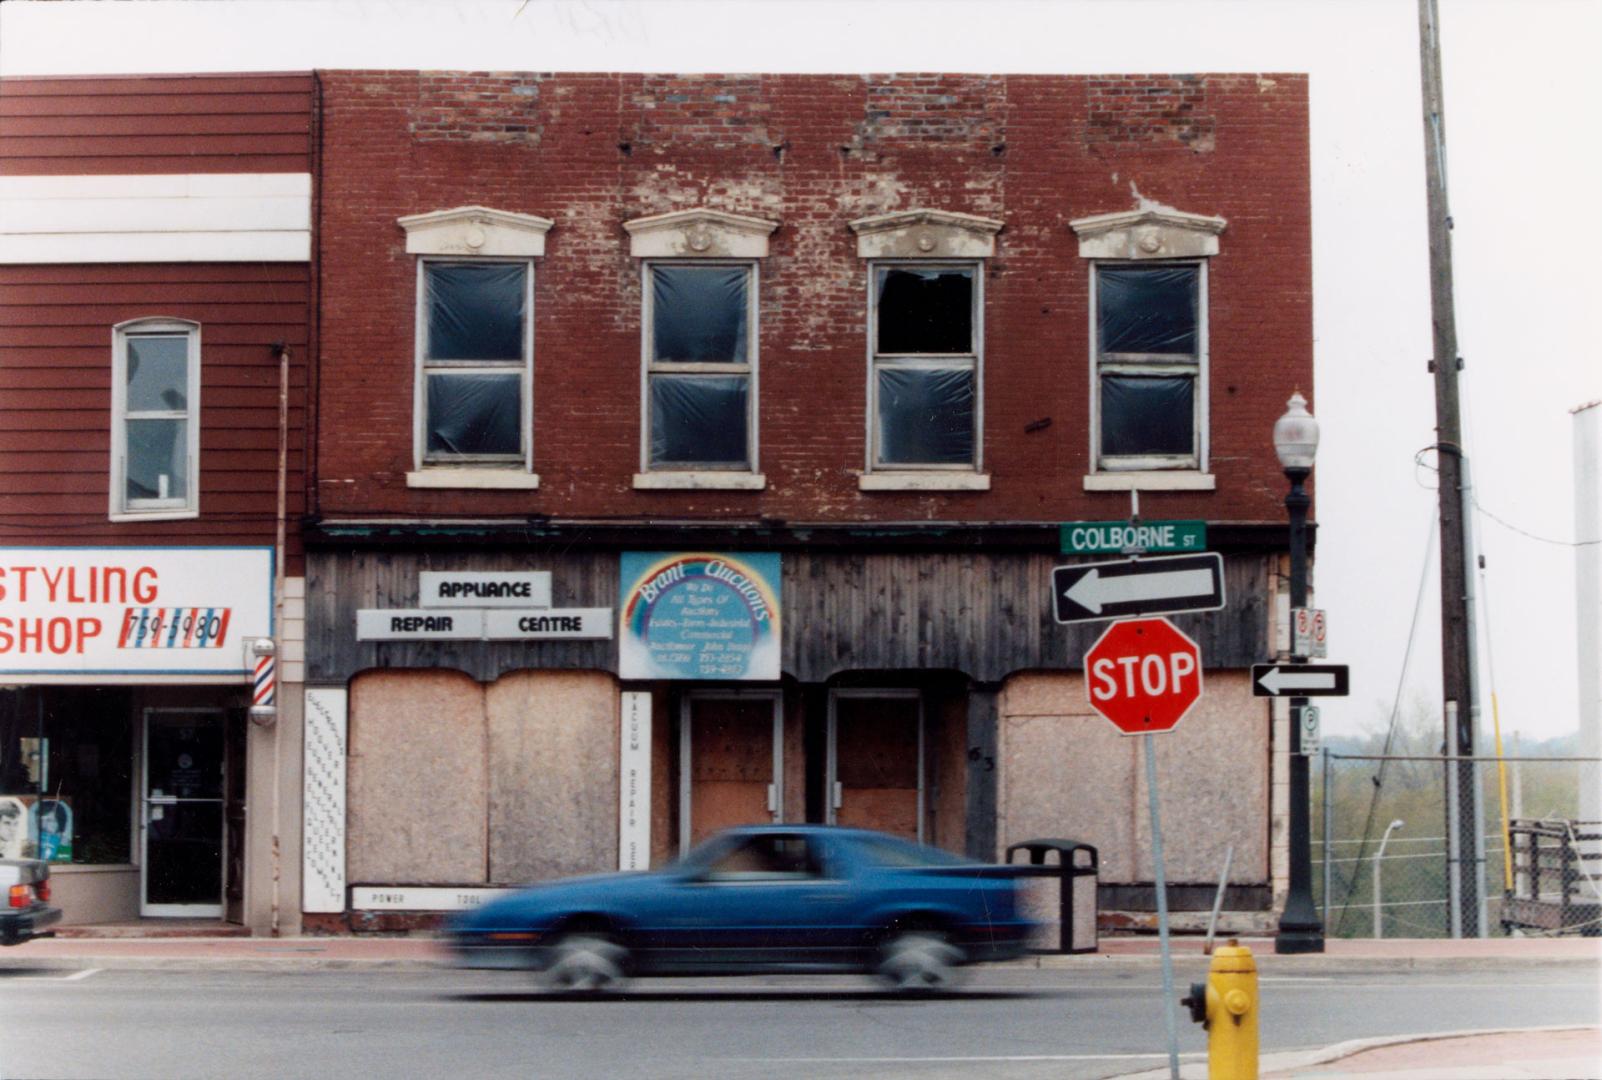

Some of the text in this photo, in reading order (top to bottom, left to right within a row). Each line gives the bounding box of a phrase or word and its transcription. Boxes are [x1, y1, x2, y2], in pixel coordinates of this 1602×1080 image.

[1071, 525, 1196, 550] COLBORNE ST
[0, 565, 159, 604] TYLING
[438, 581, 532, 598] APPLIANCE
[638, 559, 771, 622] Brant Auctions
[127, 615, 222, 641] 759-5980
[390, 615, 582, 632] REPAIR CENTRE
[1092, 651, 1195, 701] STOP
[968, 746, 995, 772] 63
[371, 893, 482, 905] POWER TOOL
